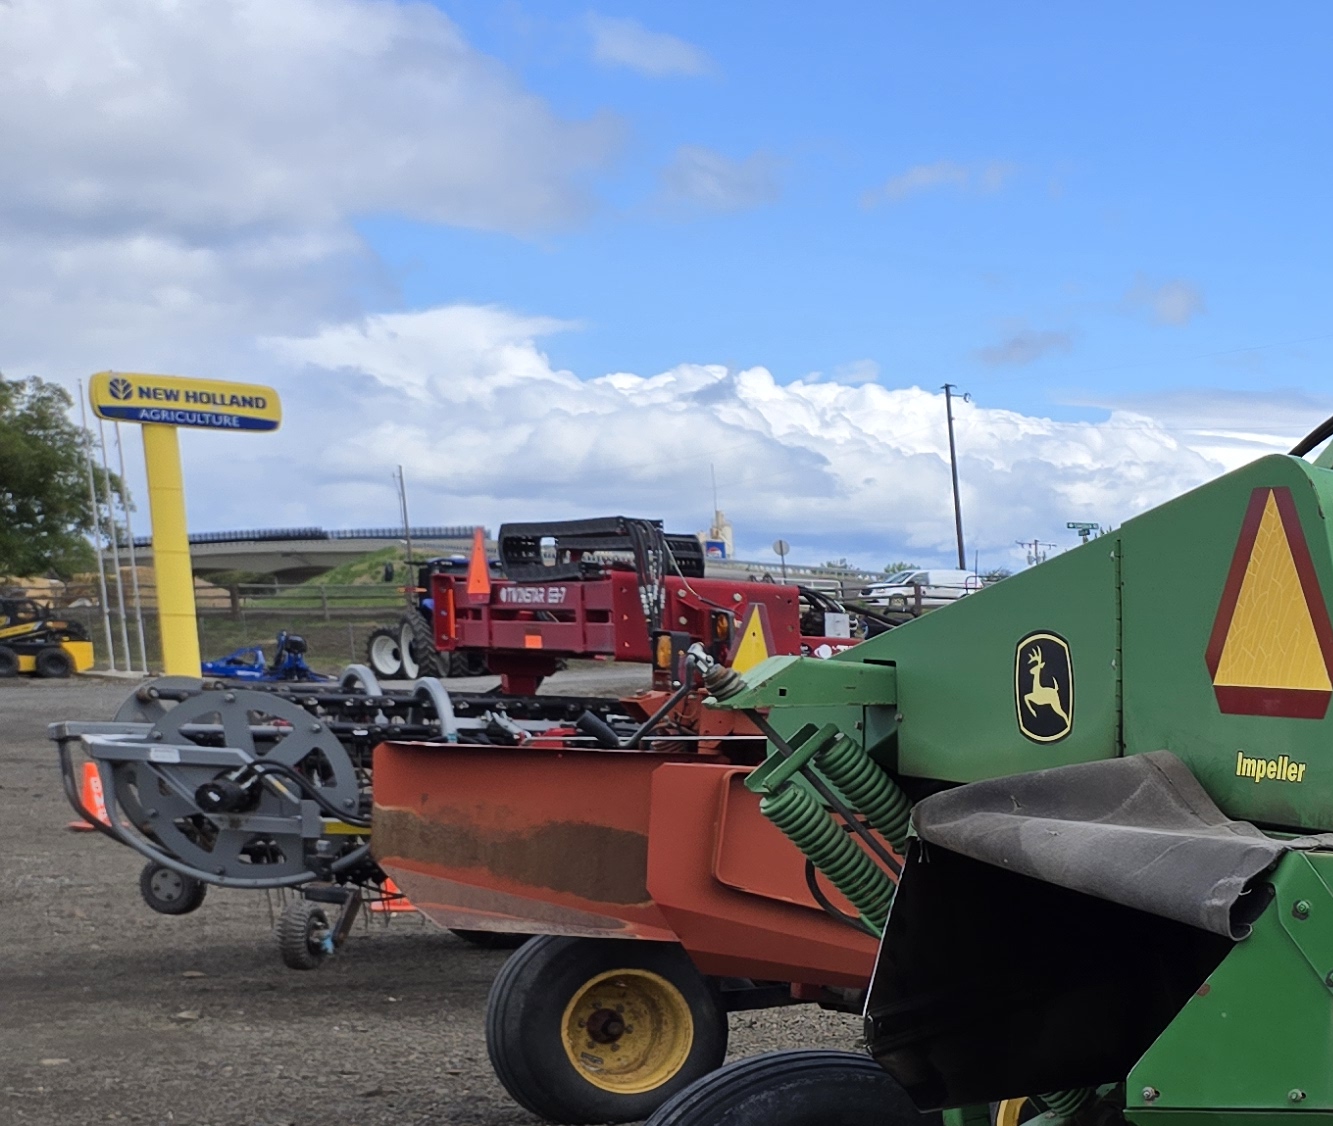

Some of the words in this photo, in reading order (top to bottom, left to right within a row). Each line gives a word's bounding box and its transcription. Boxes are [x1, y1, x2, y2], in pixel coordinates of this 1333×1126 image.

[138, 385, 180, 402] NEW
[185, 391, 267, 409] HOLLAND
[139, 408, 241, 427] AGRICULTURE
[1235, 750, 1306, 784] Impeller
